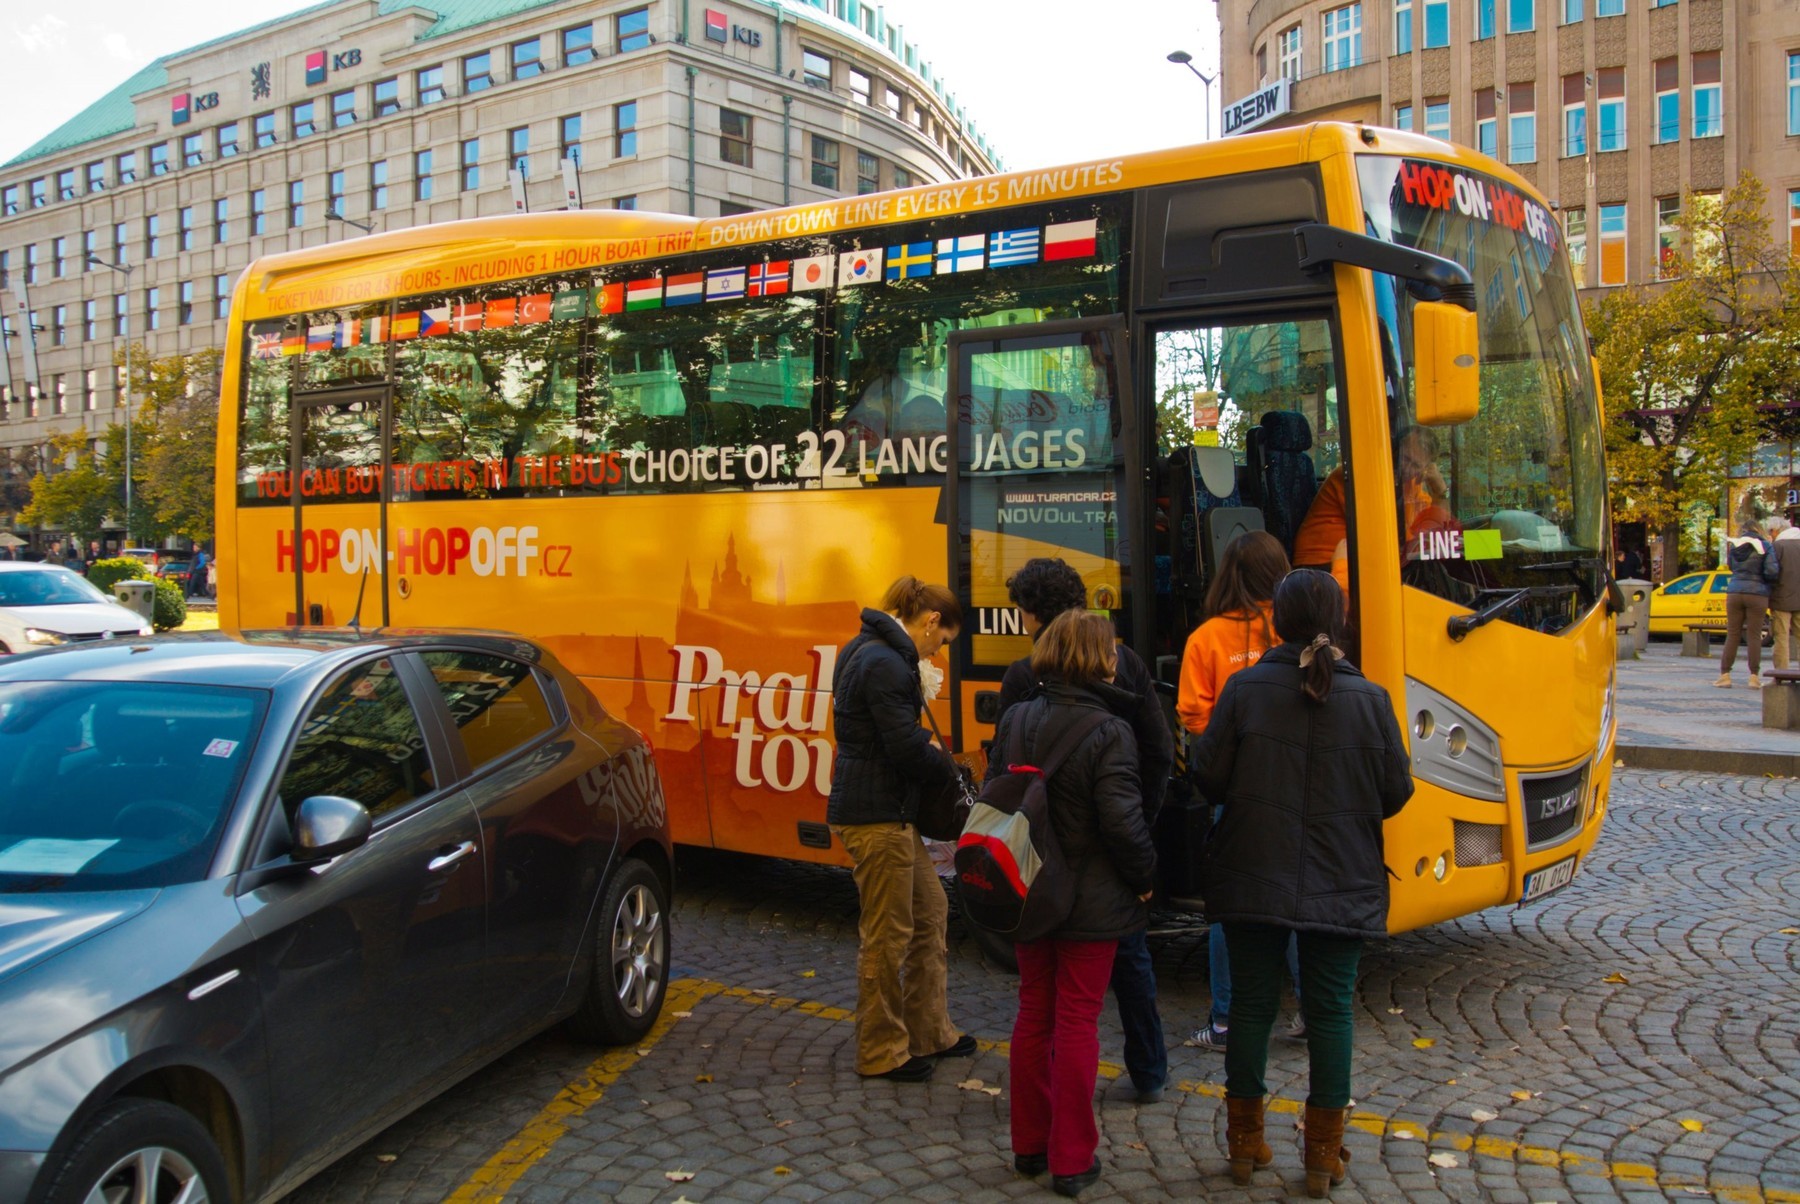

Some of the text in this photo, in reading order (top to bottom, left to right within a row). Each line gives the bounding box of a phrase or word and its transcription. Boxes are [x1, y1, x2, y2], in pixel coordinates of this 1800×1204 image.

[733, 24, 762, 47] KB
[332, 49, 362, 72] KB
[194, 92, 220, 112] KB
[267, 292, 306, 312] TICKET
[309, 284, 343, 305] VALID
[347, 281, 371, 300] FOR
[394, 269, 441, 292] HOURS
[454, 254, 536, 284] INCLUDING
[541, 253, 549, 270] 1
[553, 246, 601, 268] HOUR
[606, 238, 651, 261] BOAT
[656, 231, 694, 253] TRIP
[710, 207, 837, 246] DOWNTOWN
[844, 198, 892, 224] LINE
[896, 187, 967, 217] EVERY
[973, 182, 1000, 206] 15
[1007, 161, 1124, 200] MINUTES
[256, 470, 294, 498] YOU
[301, 467, 340, 496] CAN
[346, 464, 385, 494] BUY
[392, 459, 477, 493] TICKETS
[484, 457, 508, 489] IN
[514, 454, 561, 487] THE
[570, 452, 622, 485] BUS
[629, 447, 735, 484] CHOICE
[744, 443, 785, 480] OF
[796, 429, 847, 478] 22
[1419, 530, 1461, 561] LINE
[979, 607, 1029, 635] LIN
[1541, 788, 1578, 819] ISUZU
